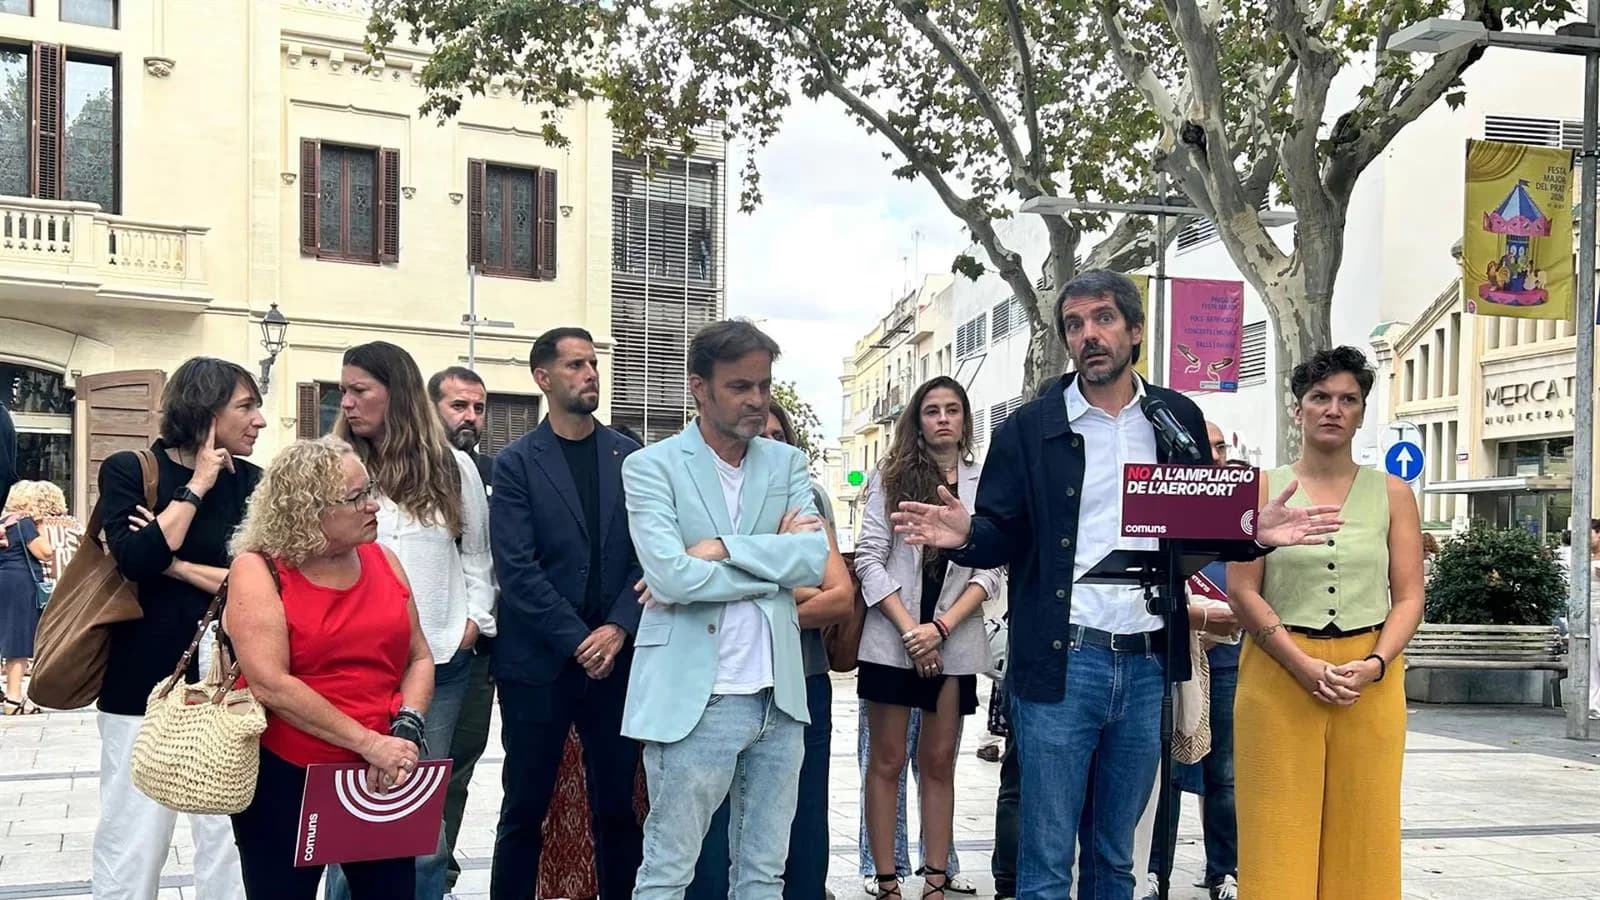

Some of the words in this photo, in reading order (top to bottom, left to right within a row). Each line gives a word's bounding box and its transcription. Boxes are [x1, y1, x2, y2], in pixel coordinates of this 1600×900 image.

[1547, 166, 1567, 175] FESTA
[1544, 174, 1566, 184] MAJOR
[1535, 183, 1548, 191] DEL
[1550, 184, 1565, 193] PRAT
[1485, 376, 1576, 407] MERCAT
[1128, 467, 1149, 480] NO
[1152, 468, 1163, 481] A
[1166, 467, 1254, 482] L'AMPLIACIÓ
[1127, 481, 1146, 494] DE
[1148, 482, 1236, 496] L'AEROPORT
[1125, 525, 1167, 533] comuns
[304, 813, 318, 861] comuns
